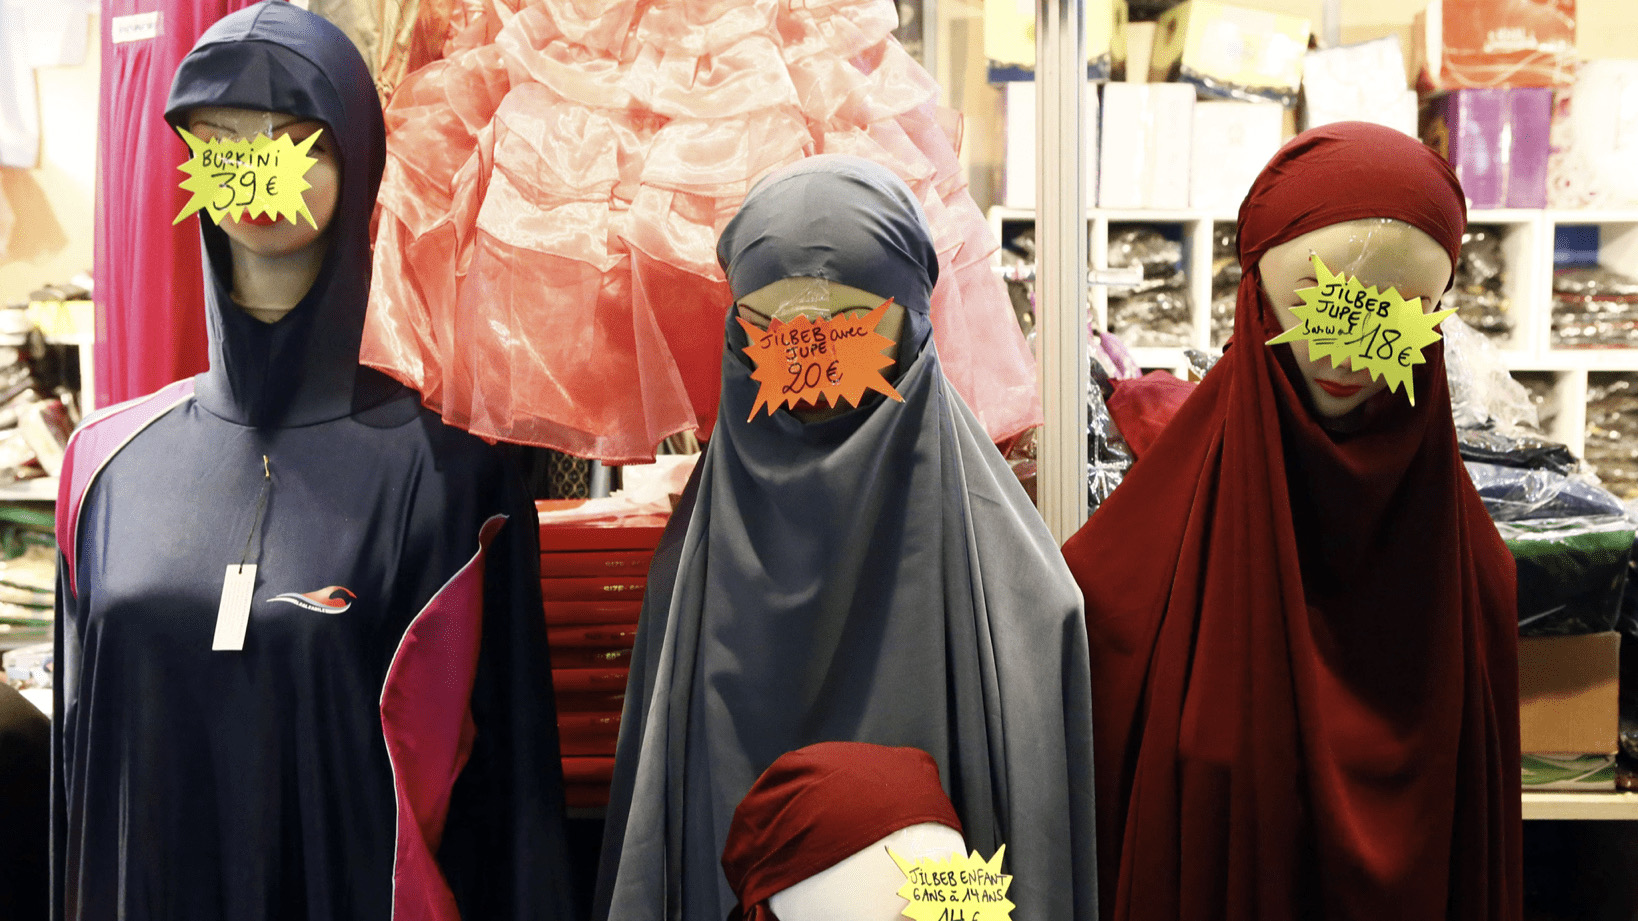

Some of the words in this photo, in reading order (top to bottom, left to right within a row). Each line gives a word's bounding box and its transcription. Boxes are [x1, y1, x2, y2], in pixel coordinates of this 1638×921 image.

[211, 170, 257, 211] 39
[265, 175, 279, 196] €
[1316, 300, 1362, 326] JUPE
[829, 326, 868, 342] avec
[1343, 323, 1402, 360] 18
[1397, 346, 1413, 367] €
[785, 341, 827, 361] JUPE
[781, 362, 822, 395] 20
[825, 359, 844, 385] €
[960, 868, 1008, 887] ENFANT
[962, 888, 980, 903] 14
[981, 888, 1004, 903] ANS
